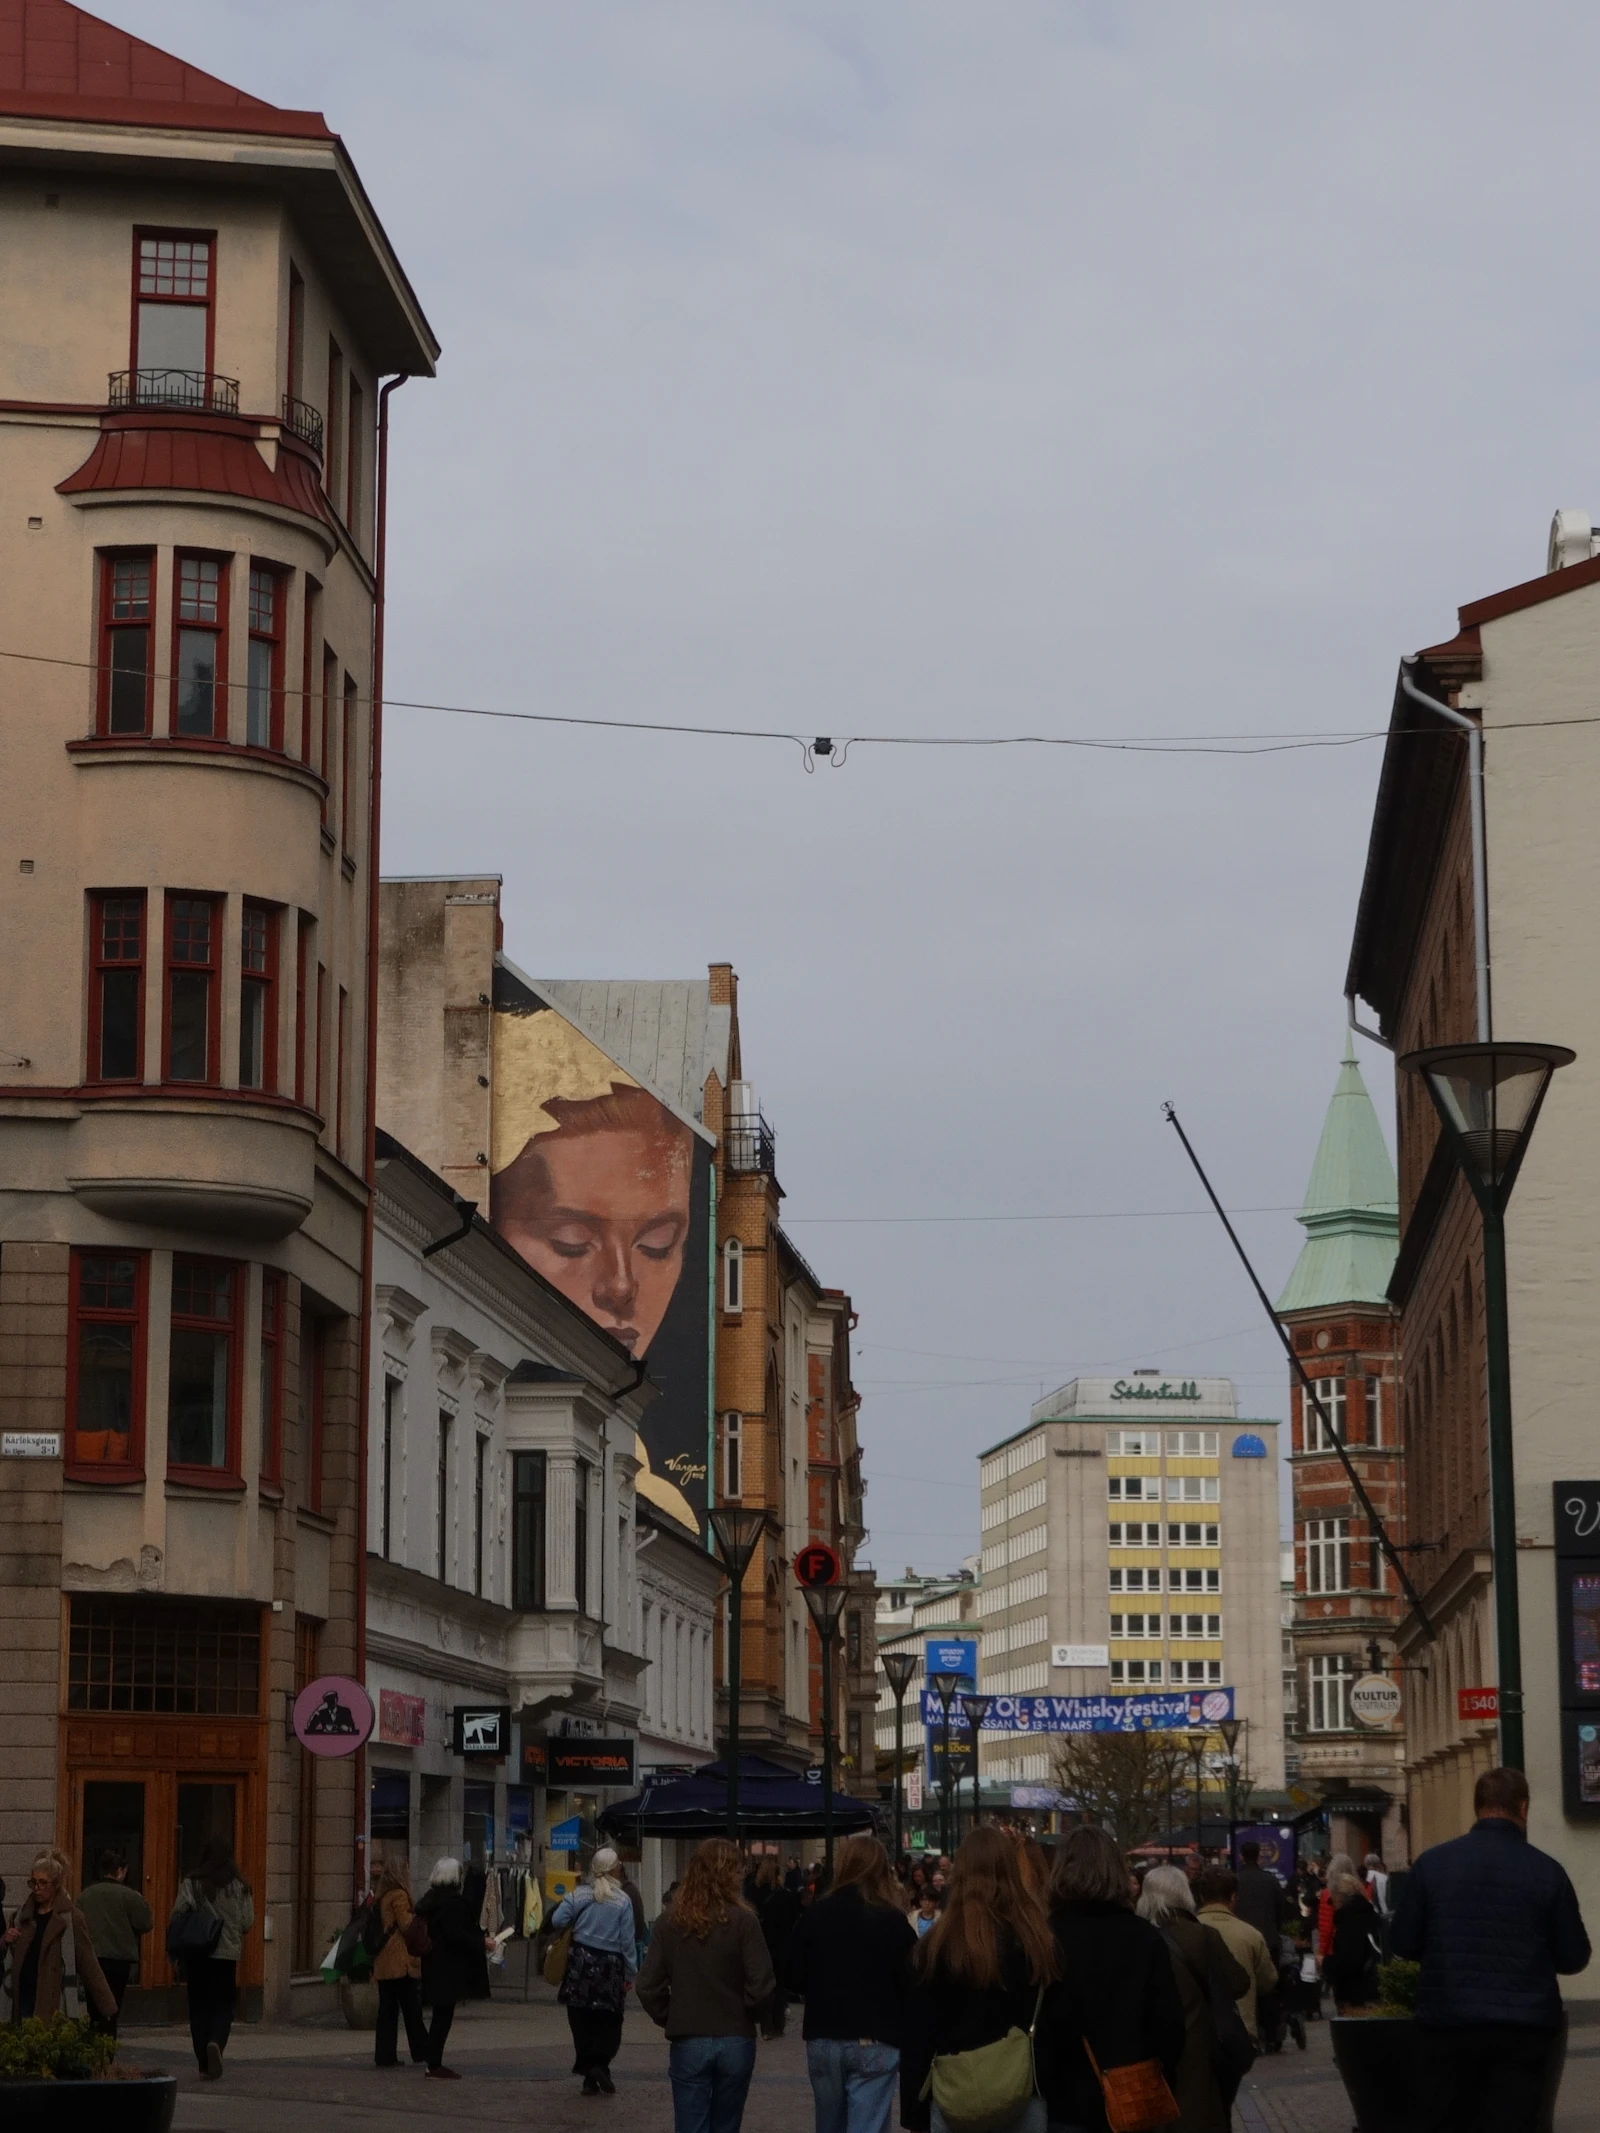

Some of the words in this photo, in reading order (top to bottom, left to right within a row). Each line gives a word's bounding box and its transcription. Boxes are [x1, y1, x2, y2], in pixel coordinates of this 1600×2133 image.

[1110, 1380, 1202, 1400] Södertull
[42, 1446, 56, 1455] 3-1
[665, 1453, 706, 1486] Vargas
[809, 1555, 825, 1579] F
[1354, 1692, 1398, 1701] KULTUR
[1353, 1702, 1400, 1710] CENTRALEN
[1462, 1696, 1496, 1710] 1540
[1033, 1699, 1050, 1718] &
[1052, 1694, 1190, 1725] Whiskyfestival
[1033, 1721, 1056, 1730] 13-14
[1060, 1721, 1092, 1731] MARS
[555, 1756, 628, 1767] VICTORIA
